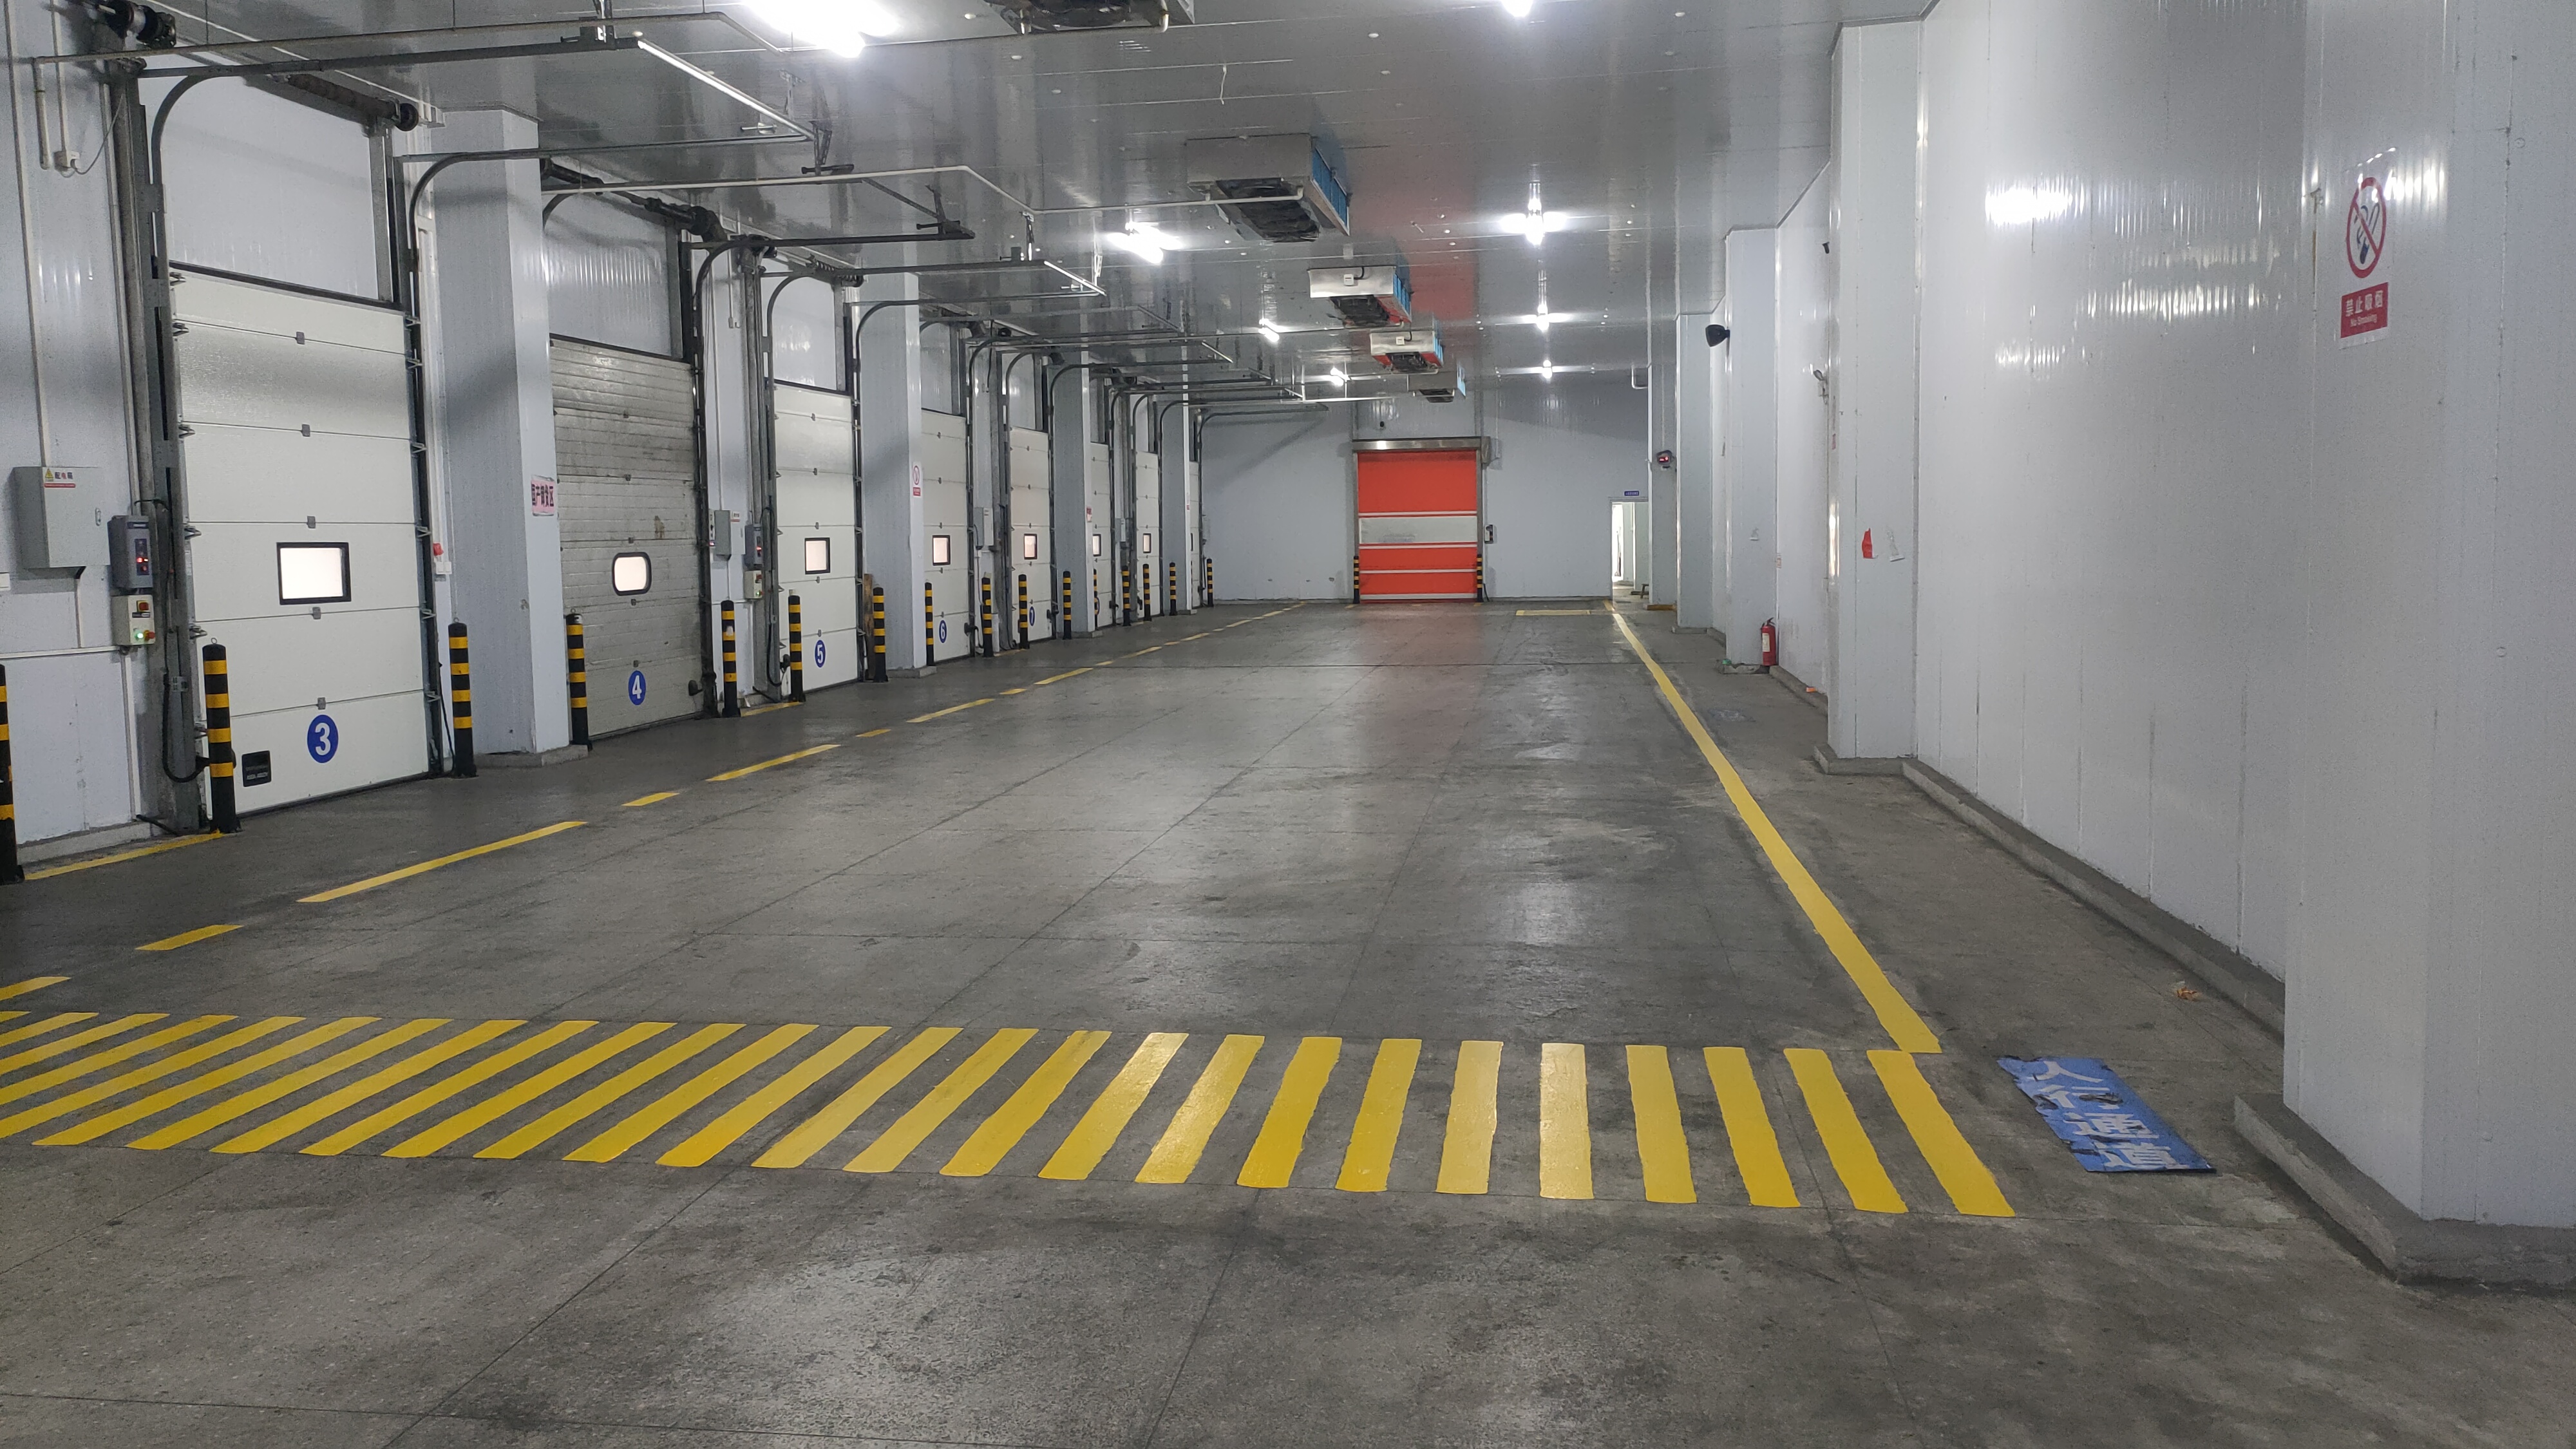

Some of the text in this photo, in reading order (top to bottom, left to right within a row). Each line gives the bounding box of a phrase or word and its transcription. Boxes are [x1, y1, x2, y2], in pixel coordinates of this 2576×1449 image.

[940, 623, 945, 639] 6
[817, 644, 824, 664] 5
[632, 675, 642, 699] 4
[315, 722, 331, 756] 3
[2027, 1061, 2190, 1170] 人行通道
